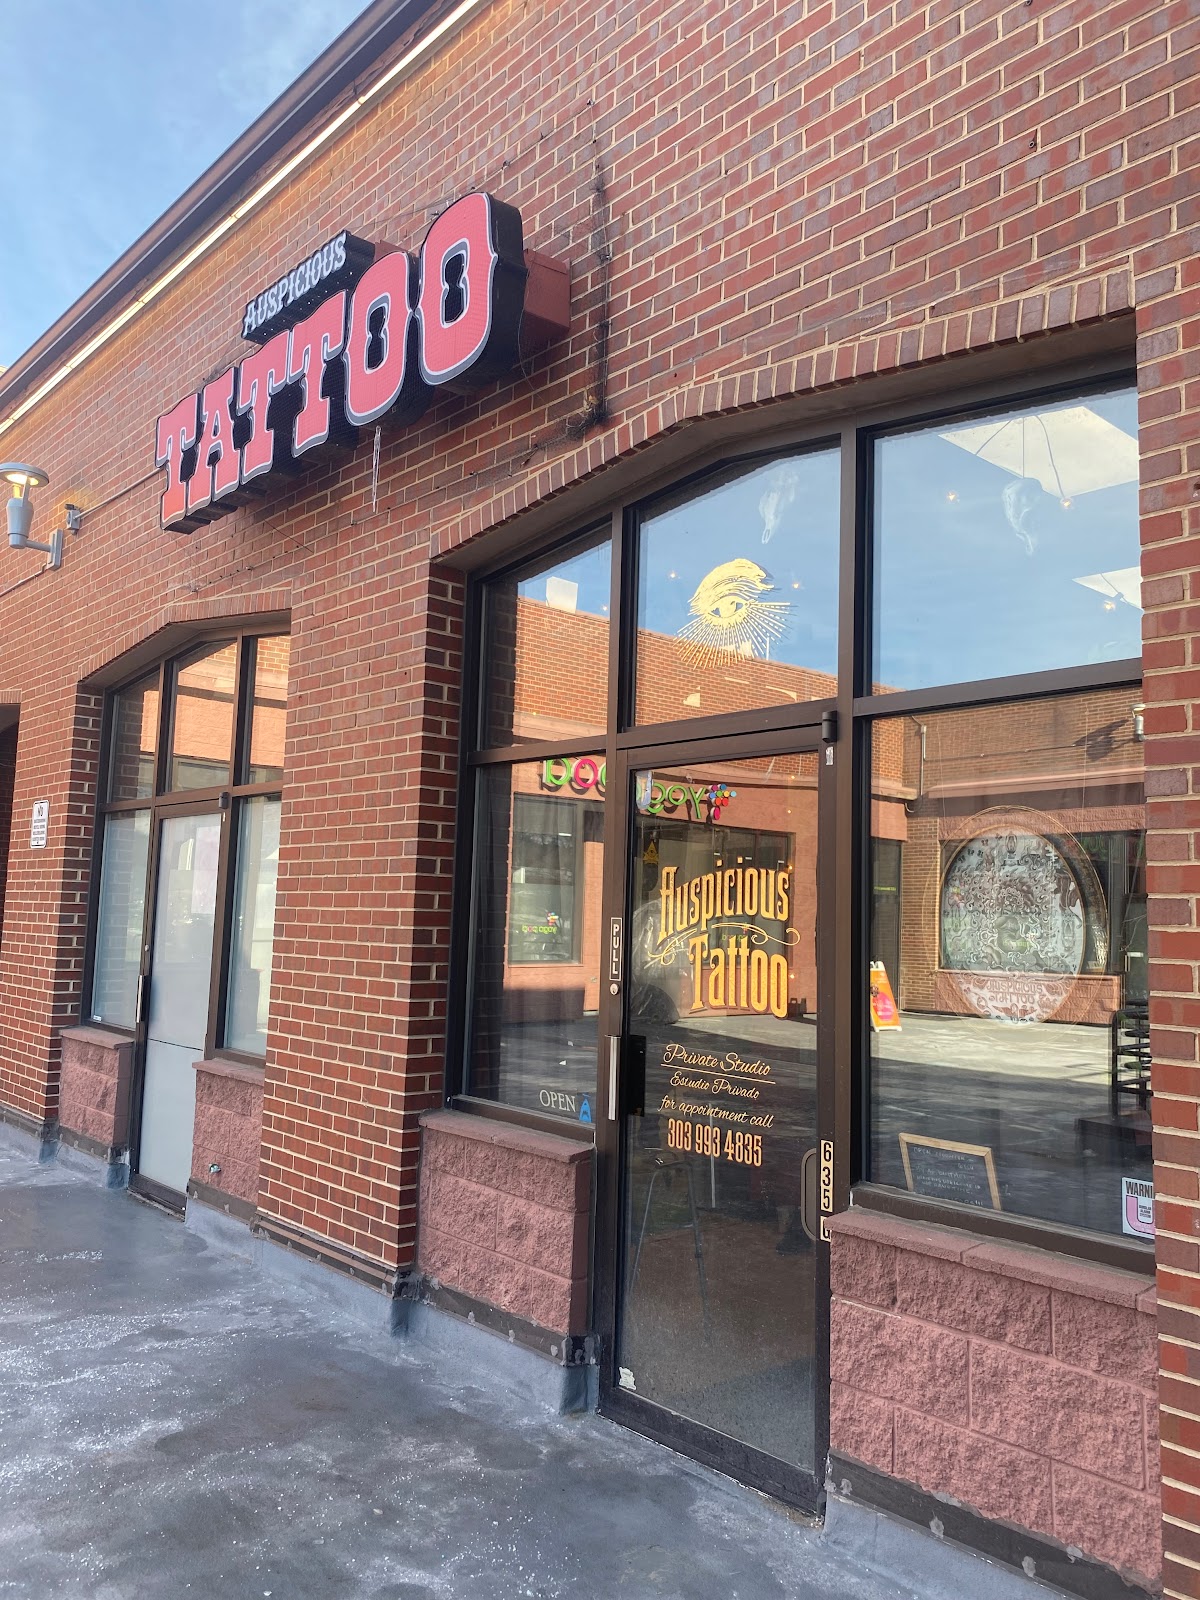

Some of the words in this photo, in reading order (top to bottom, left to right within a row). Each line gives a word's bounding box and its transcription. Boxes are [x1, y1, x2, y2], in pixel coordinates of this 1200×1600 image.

[242, 231, 347, 339] AUSPICIOUS
[155, 192, 499, 529] TATTOO
[657, 857, 790, 946] Auspicious
[612, 923, 620, 975] PULL
[688, 934, 788, 1018] Tattoo
[663, 1043, 719, 1067] Private
[719, 1052, 771, 1076] Studio
[670, 1070, 710, 1091] Estudio
[711, 1078, 760, 1099] Privado
[540, 1089, 576, 1112] OPEN
[657, 1095, 677, 1112] for
[678, 1101, 749, 1124] appointment
[749, 1114, 774, 1128] call
[667, 1118, 692, 1151] 303
[695, 1123, 720, 1158] 993
[723, 1129, 762, 1167] 4835
[822, 1142, 832, 1210] 635
[1125, 1180, 1153, 1199] WARNI
